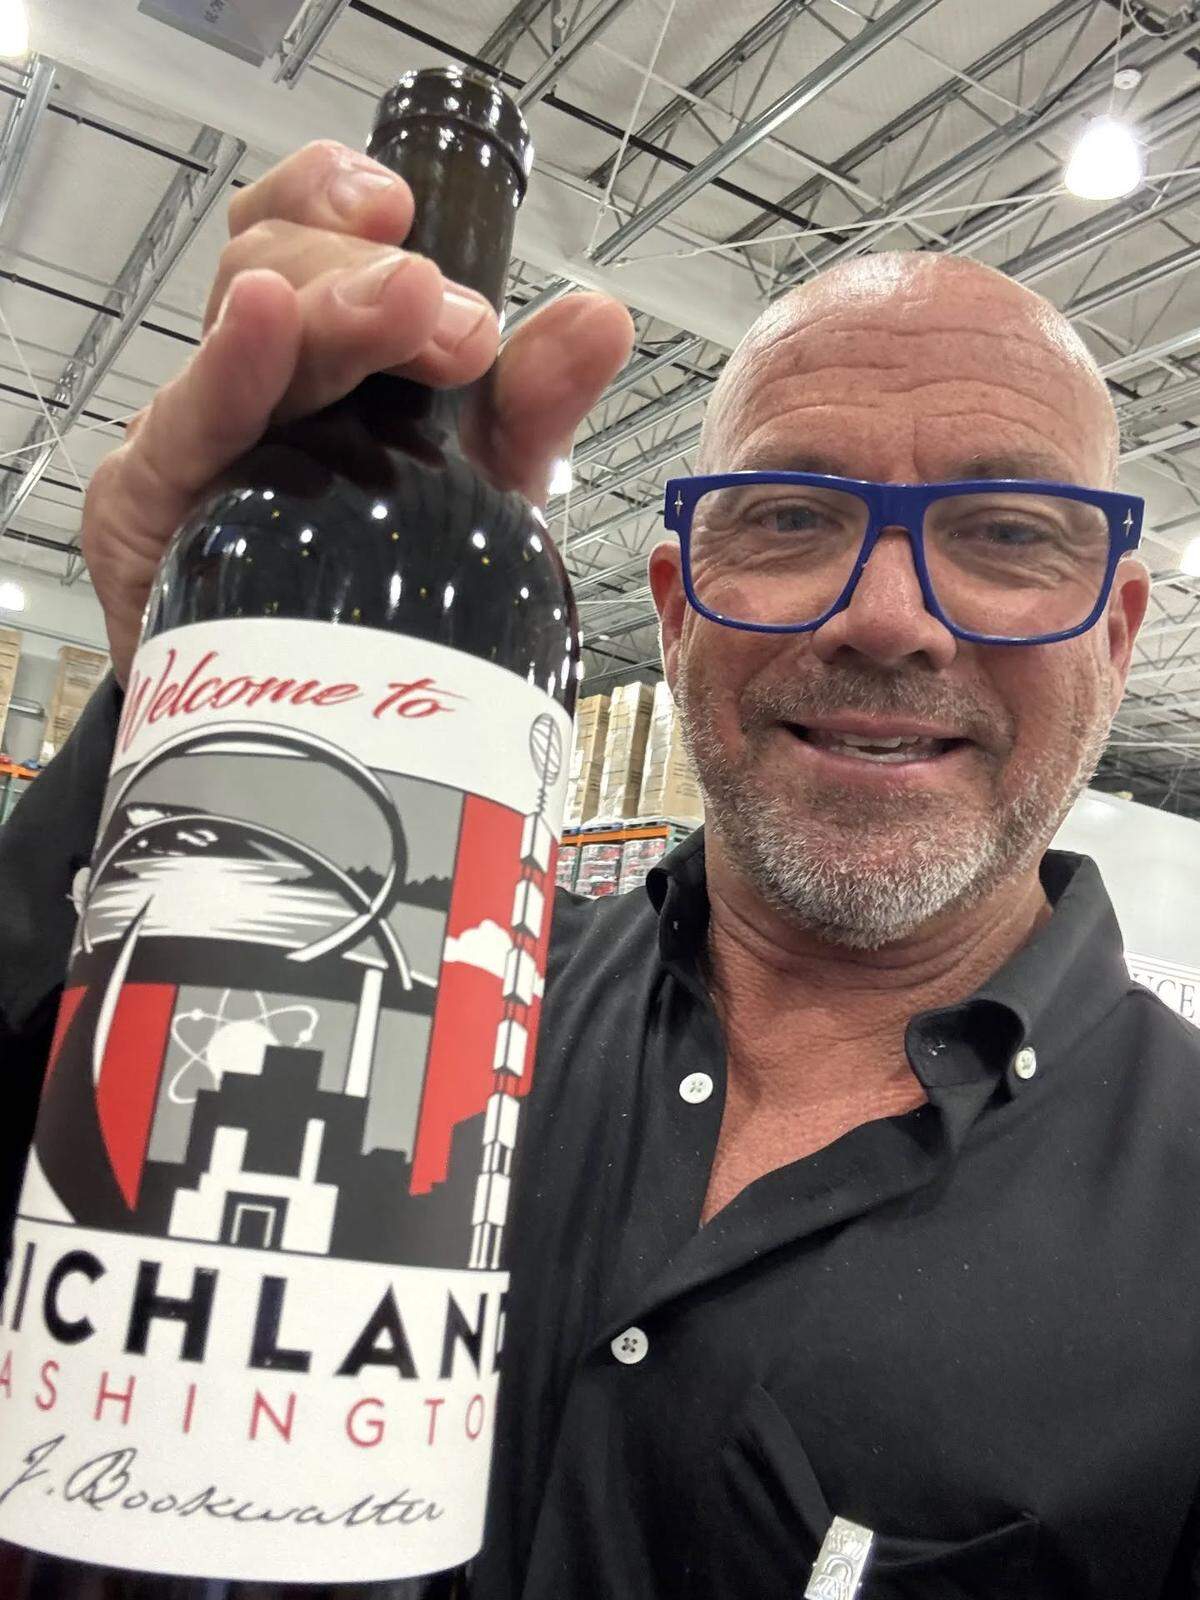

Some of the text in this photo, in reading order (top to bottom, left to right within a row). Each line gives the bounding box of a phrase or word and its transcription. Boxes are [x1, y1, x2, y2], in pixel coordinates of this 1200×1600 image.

[119, 648, 471, 755] Welcome to
[0, 1241, 508, 1380] ICHLAN
[64, 1447, 445, 1527] Bookwalter
